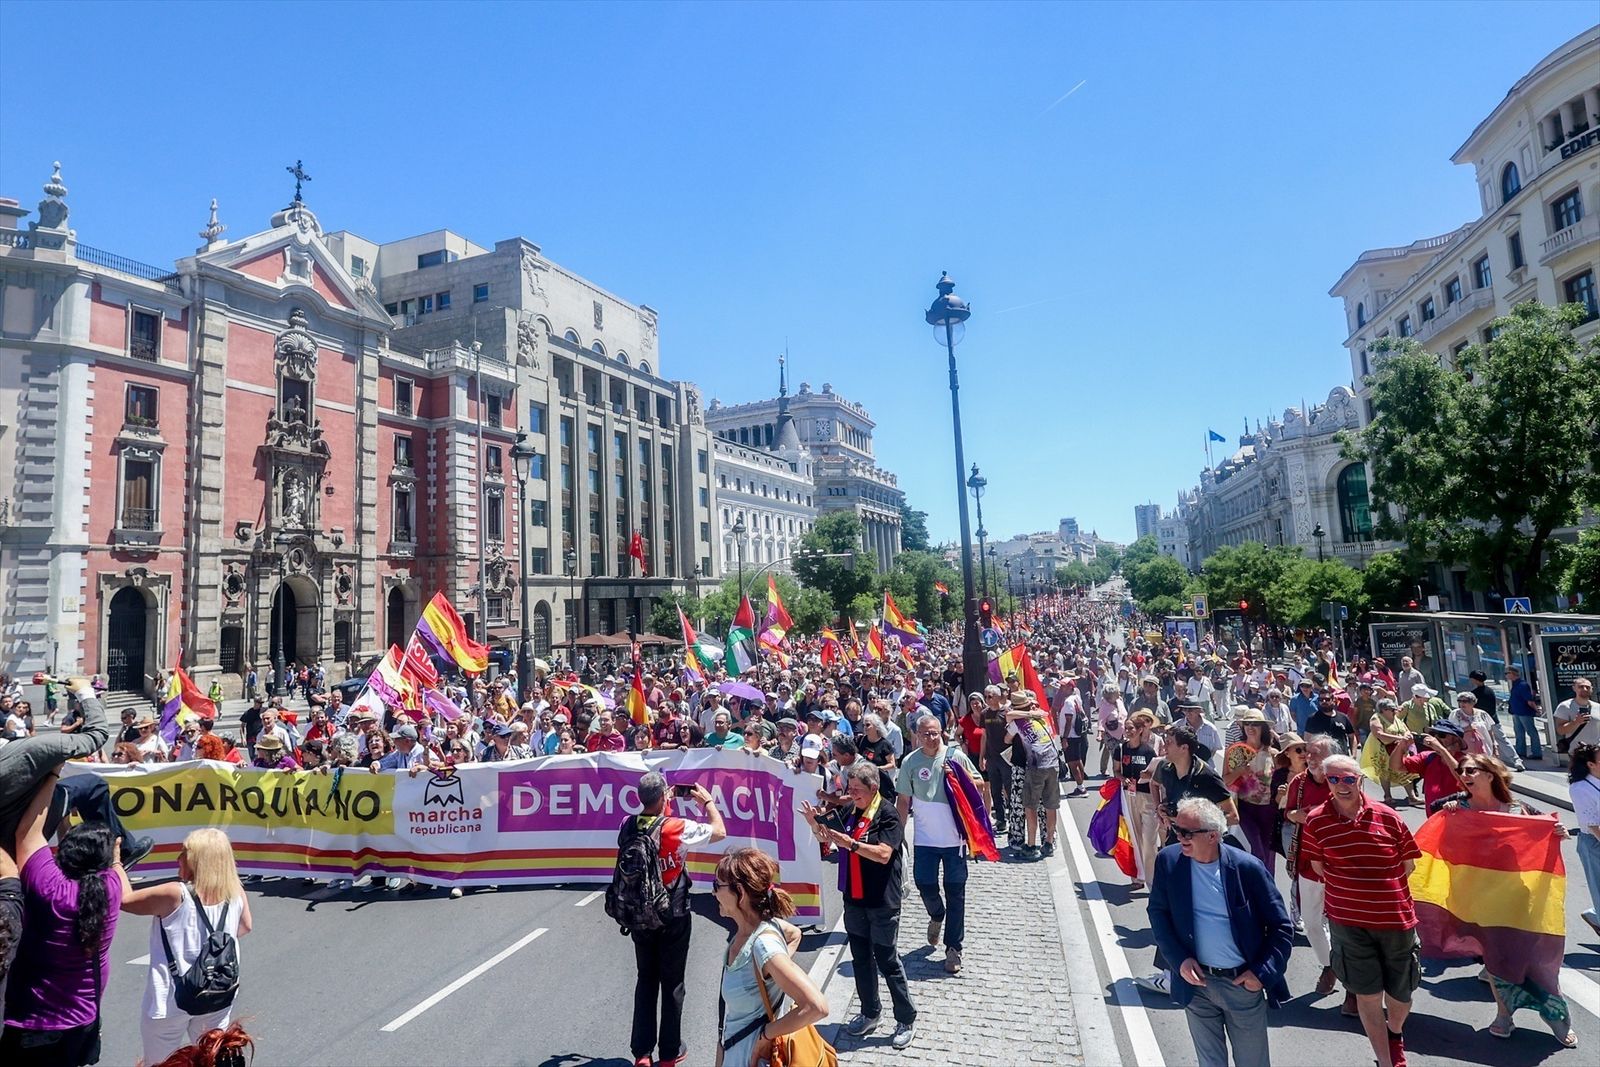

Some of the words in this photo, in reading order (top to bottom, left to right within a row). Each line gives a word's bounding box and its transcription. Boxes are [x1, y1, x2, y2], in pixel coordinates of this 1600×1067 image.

[110, 778, 327, 820] ONARQUÍA
[512, 783, 778, 823] DEMORACIA
[408, 806, 483, 823] marcha
[410, 823, 482, 836] republicana
